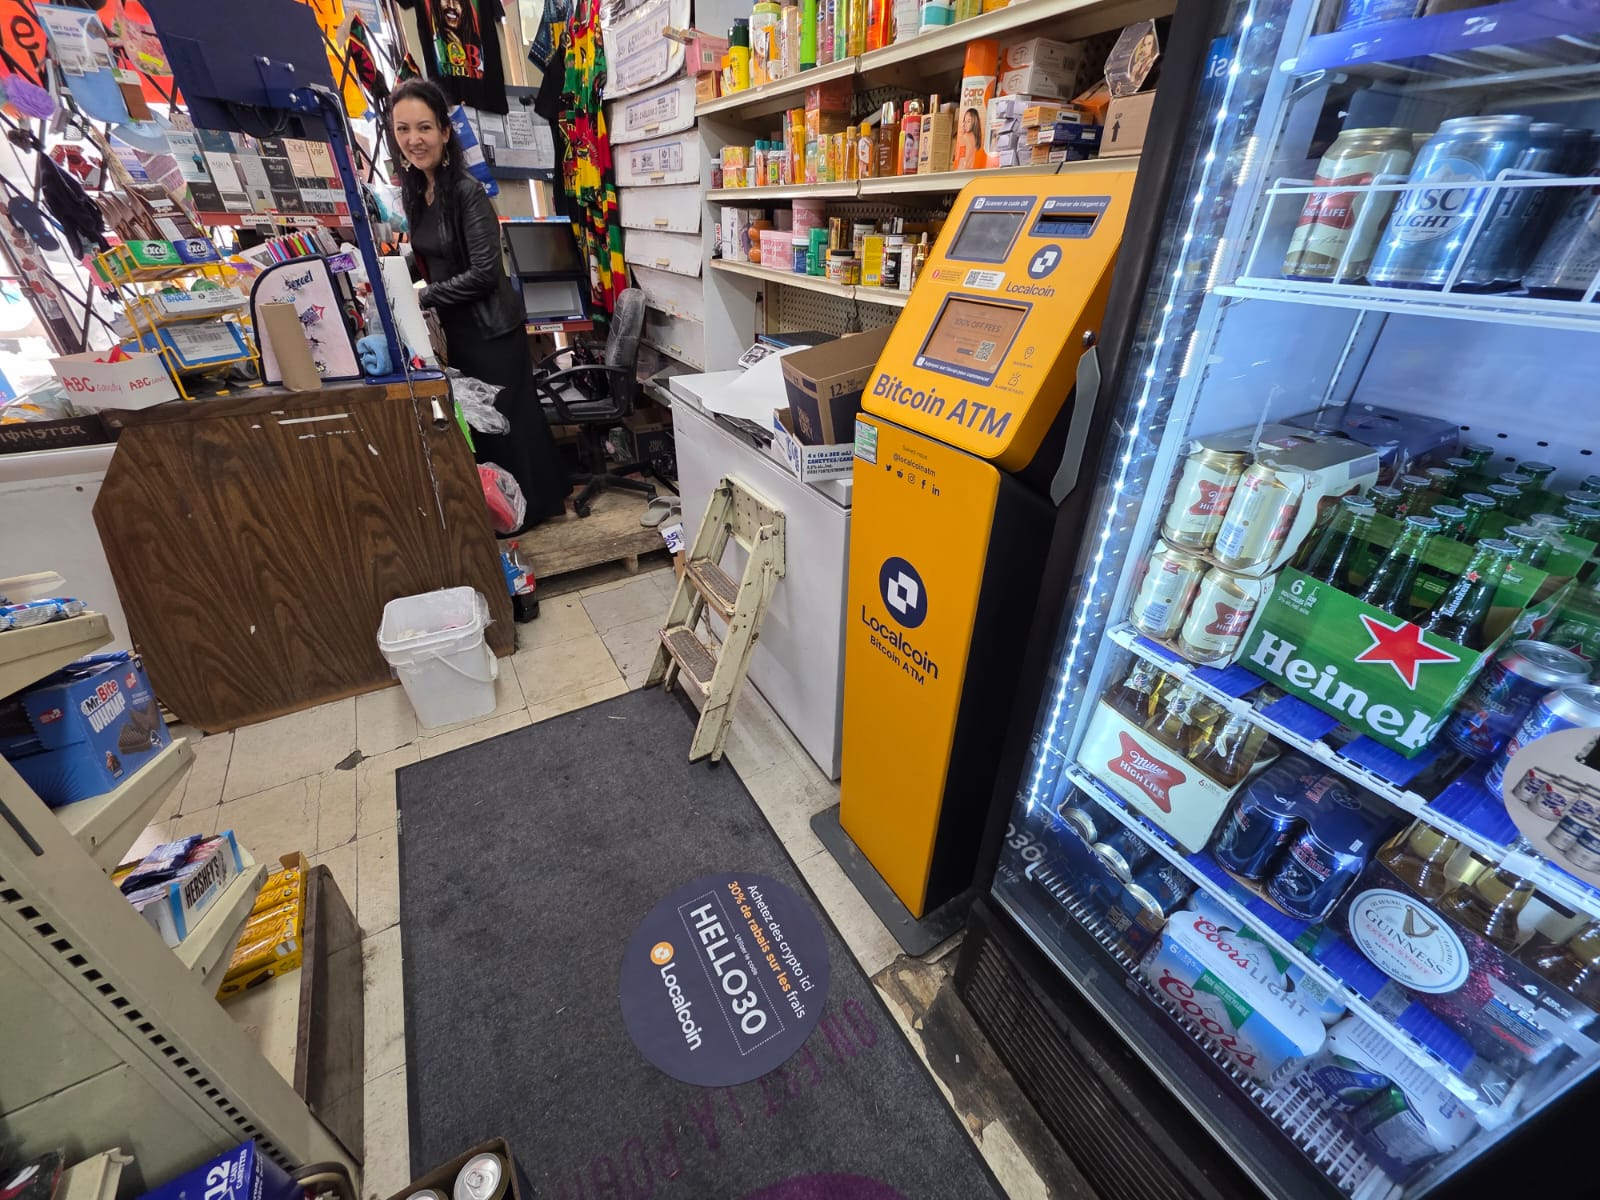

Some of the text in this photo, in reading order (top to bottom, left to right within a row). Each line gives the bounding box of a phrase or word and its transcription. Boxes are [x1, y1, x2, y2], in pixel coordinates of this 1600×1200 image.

[1322, 208, 1346, 217] LIFE
[1393, 184, 1487, 213] BUSCH
[1393, 214, 1451, 229] LIGHT
[1005, 281, 1056, 298] Localcoin
[62, 376, 96, 393] ABC
[128, 377, 151, 392] ABC
[830, 383, 843, 398] 12
[871, 373, 1013, 439] Bitcoin ATM
[1290, 579, 1306, 595] 6
[861, 604, 939, 680] Localcoin
[869, 633, 925, 686] Bitcoin ATM
[96, 679, 119, 702] Bite
[1119, 760, 1166, 800] HIGH LIFE
[184, 855, 220, 910] HERSHEY'S
[727, 880, 806, 1019] 30% de rabais sur les frais
[747, 884, 815, 992] Achetez des crypto ici
[1193, 915, 1250, 970] Coors
[1365, 909, 1446, 975] GUINNESS
[689, 902, 767, 1036] HELLO30
[747, 959, 758, 976] code
[660, 961, 703, 1052] Localcoin
[1249, 967, 1310, 1018] LIGHT
[1158, 968, 1257, 1070] Coors
[229, 1160, 239, 1183] CANS
